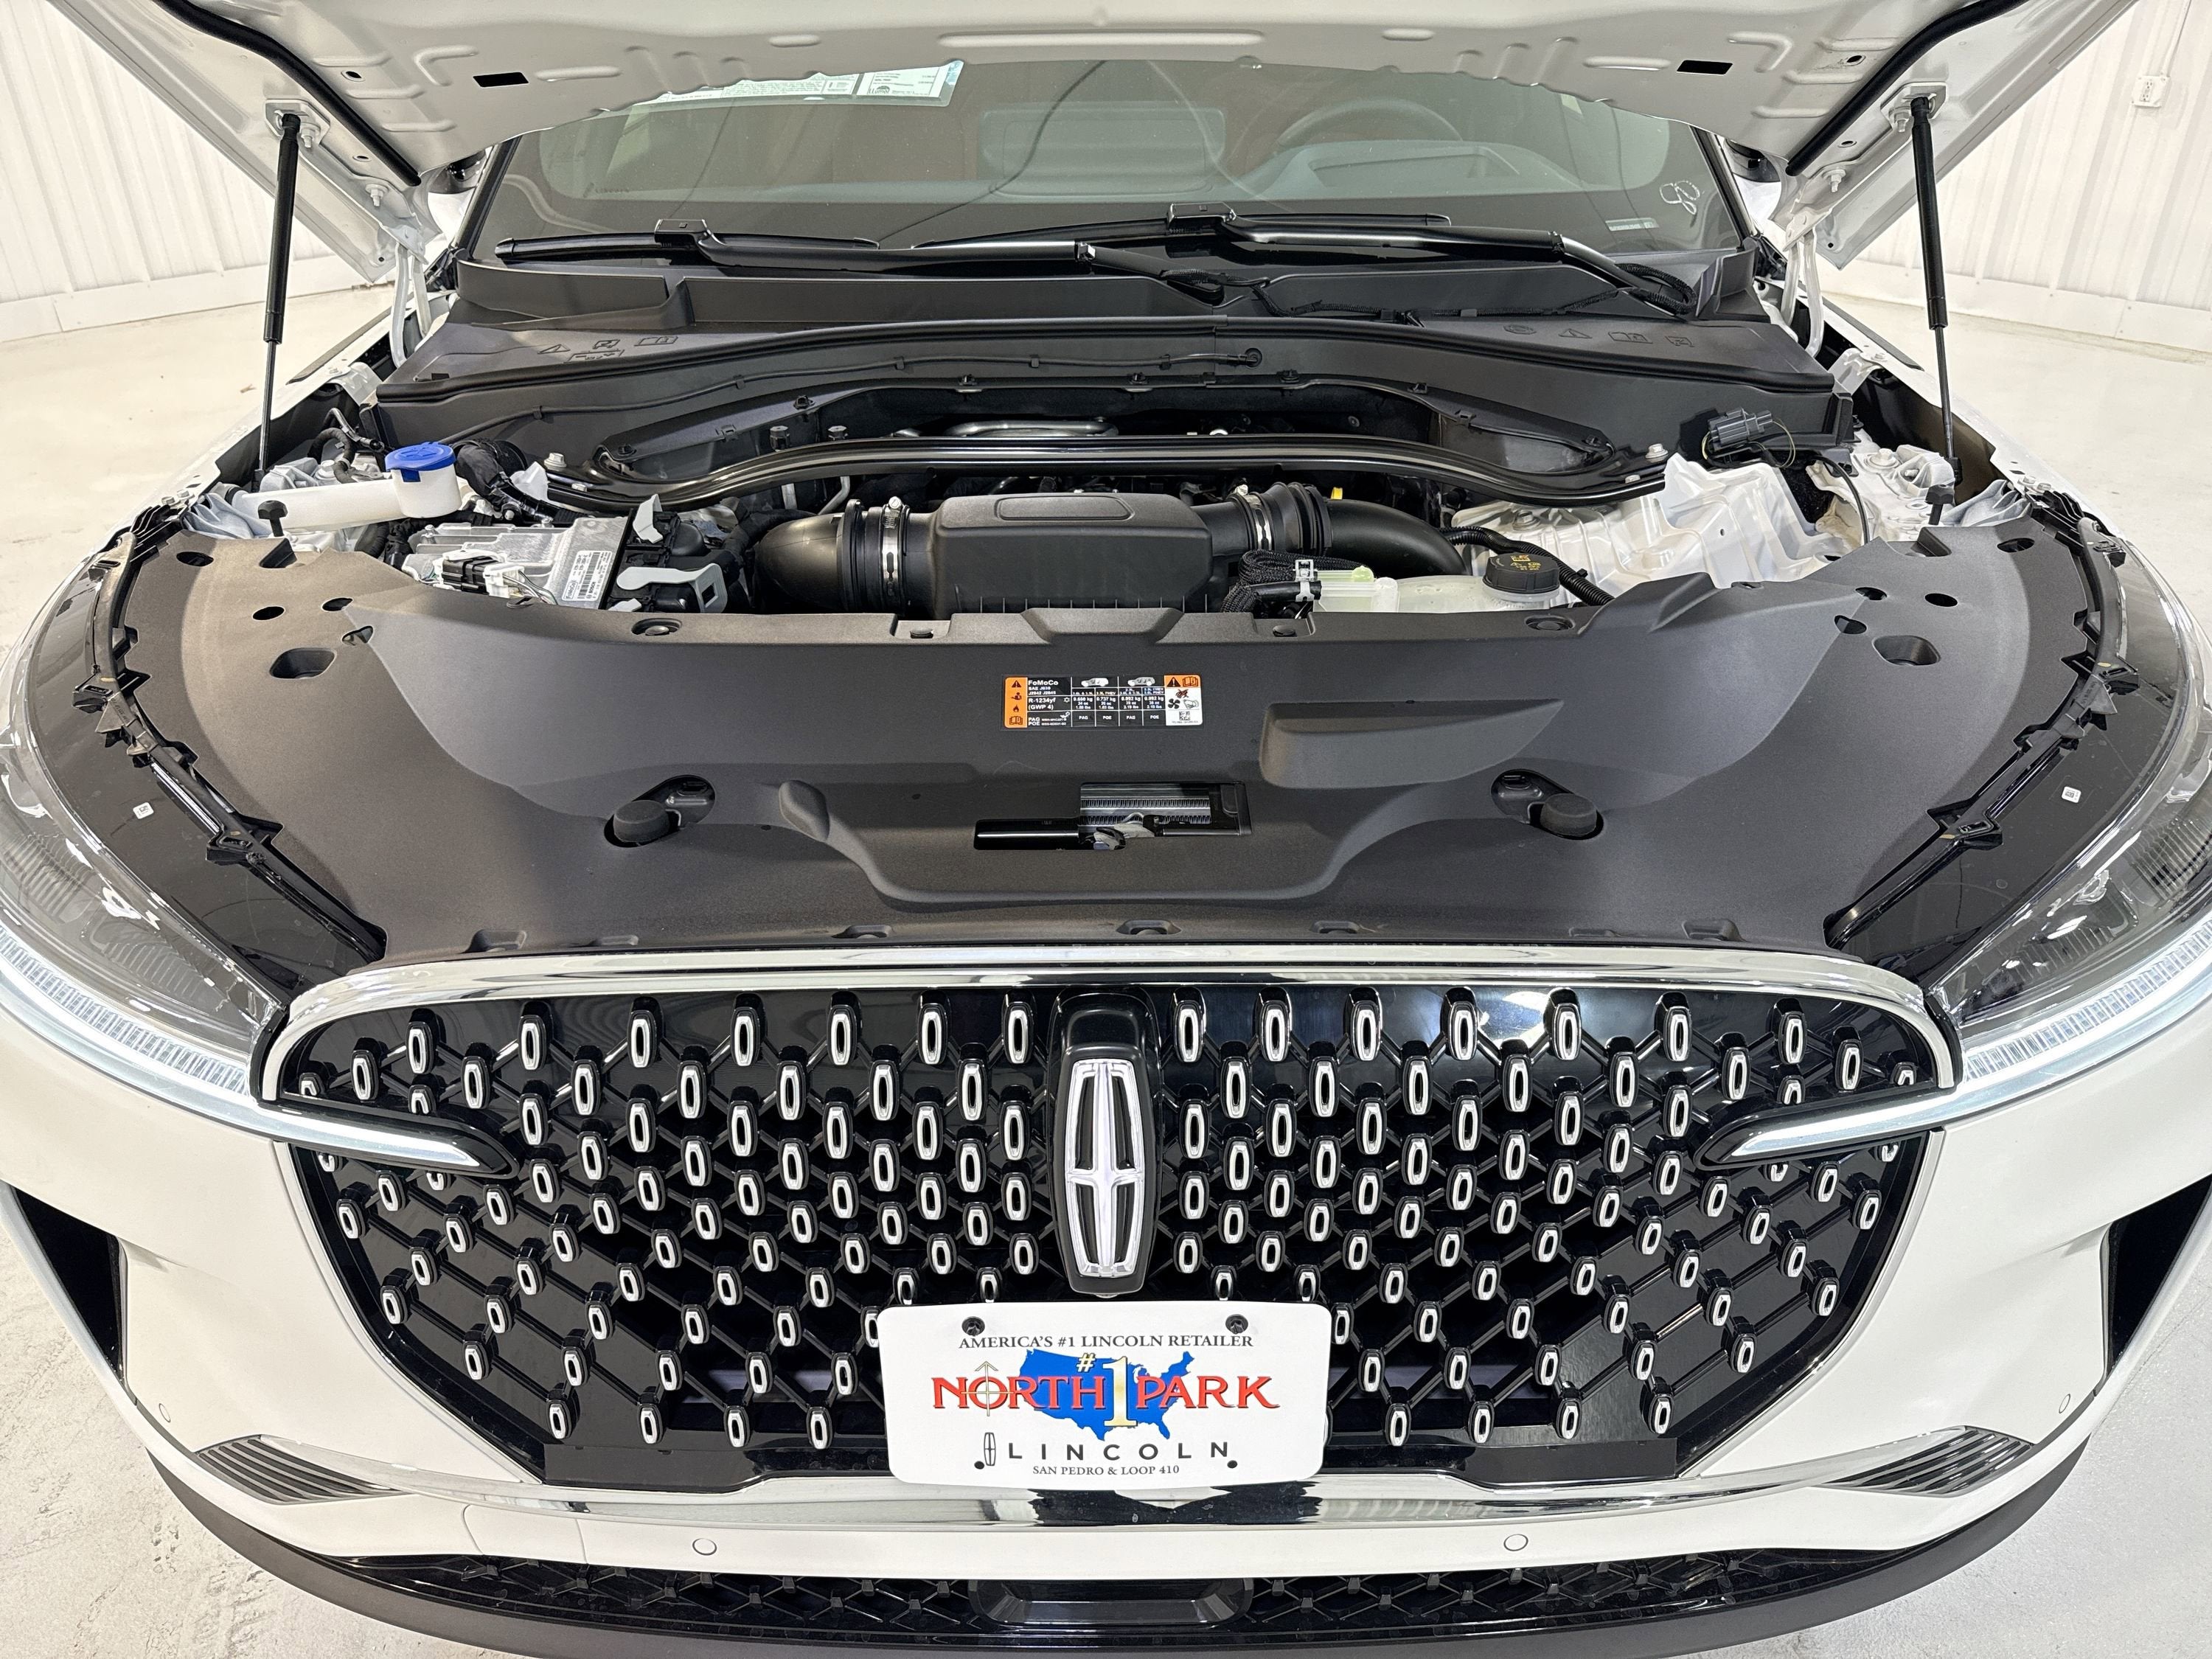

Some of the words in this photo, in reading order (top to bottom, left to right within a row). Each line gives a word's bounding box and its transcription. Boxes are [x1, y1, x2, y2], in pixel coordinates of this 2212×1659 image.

[959, 1336, 1053, 1349] AMERICA'S
[1058, 1336, 1074, 1347] #1
[1081, 1335, 1163, 1347] LINCOLN
[1168, 1335, 1253, 1346] RETAILER
[931, 1377, 1105, 1410] NORTH
[1136, 1376, 1280, 1409] PARK
[1009, 1441, 1228, 1461] LINCOLN
[1033, 1466, 1057, 1475] SAN
[1061, 1467, 1104, 1475] PEDRO
[1107, 1467, 1117, 1475] &
[1121, 1467, 1155, 1475] LOOP
[1159, 1465, 1180, 1474] 410
